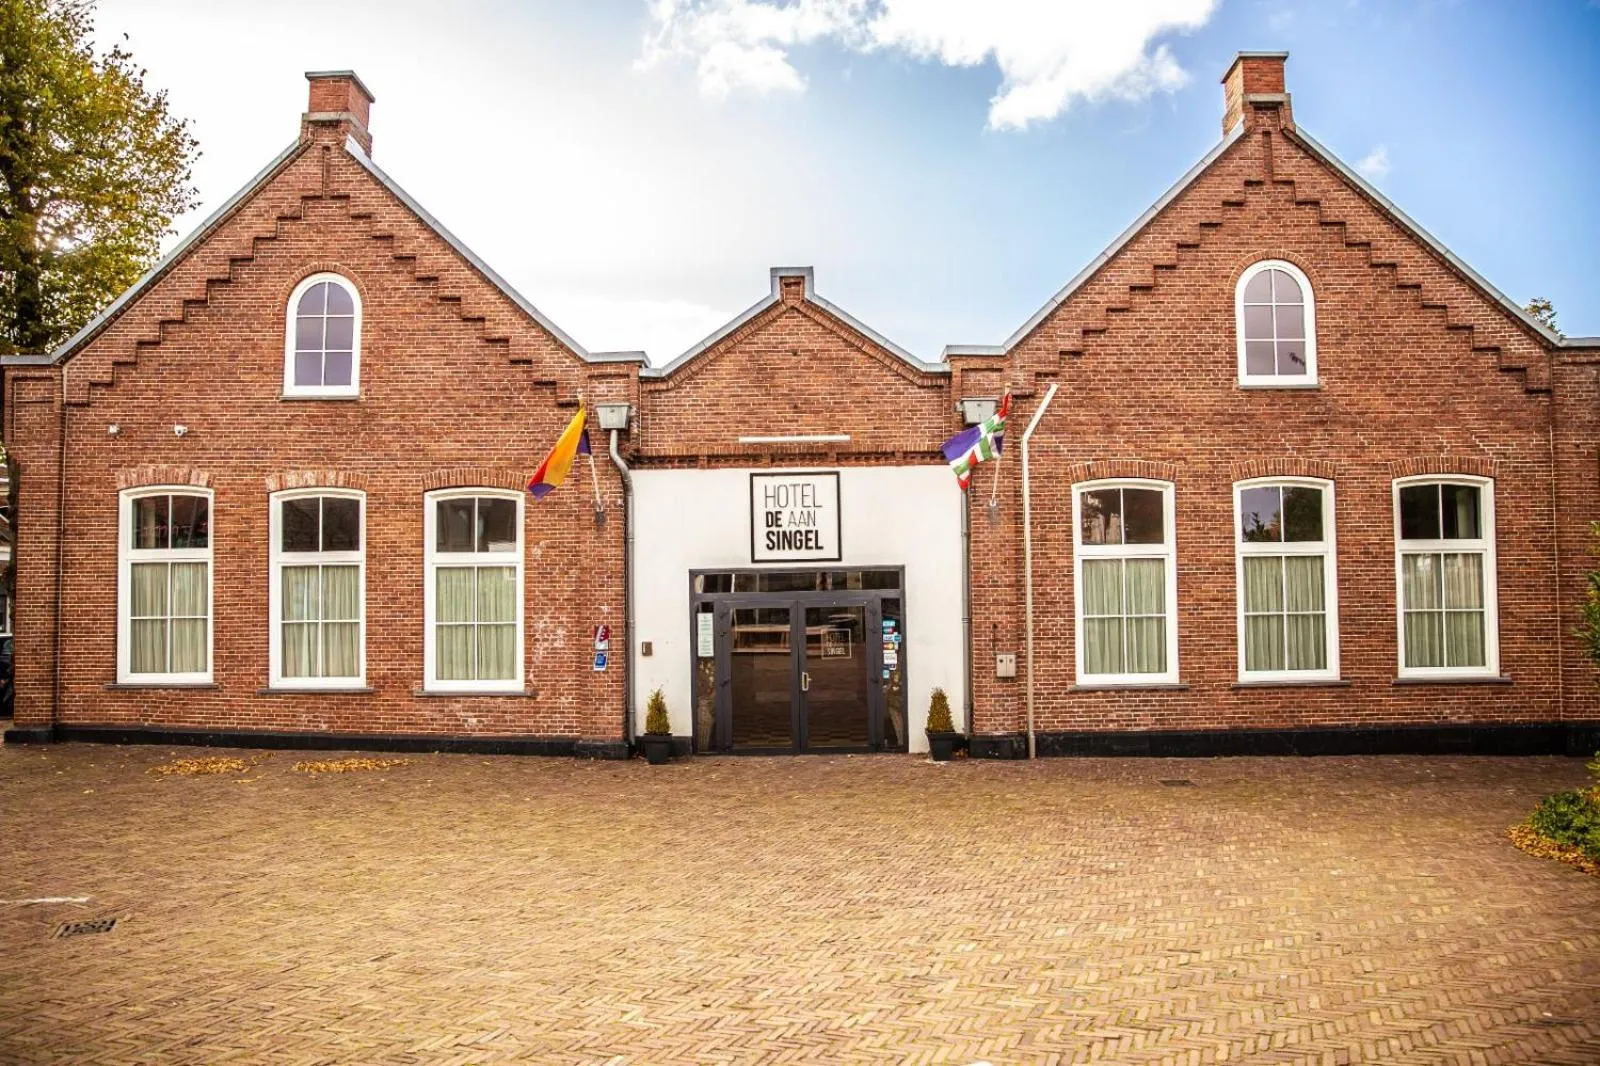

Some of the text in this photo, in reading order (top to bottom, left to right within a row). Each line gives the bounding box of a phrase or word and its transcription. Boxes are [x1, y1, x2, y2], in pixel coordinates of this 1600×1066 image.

[764, 483, 823, 508] HOTEL
[765, 510, 816, 528] DE AAN
[765, 530, 824, 551] SINGEL
